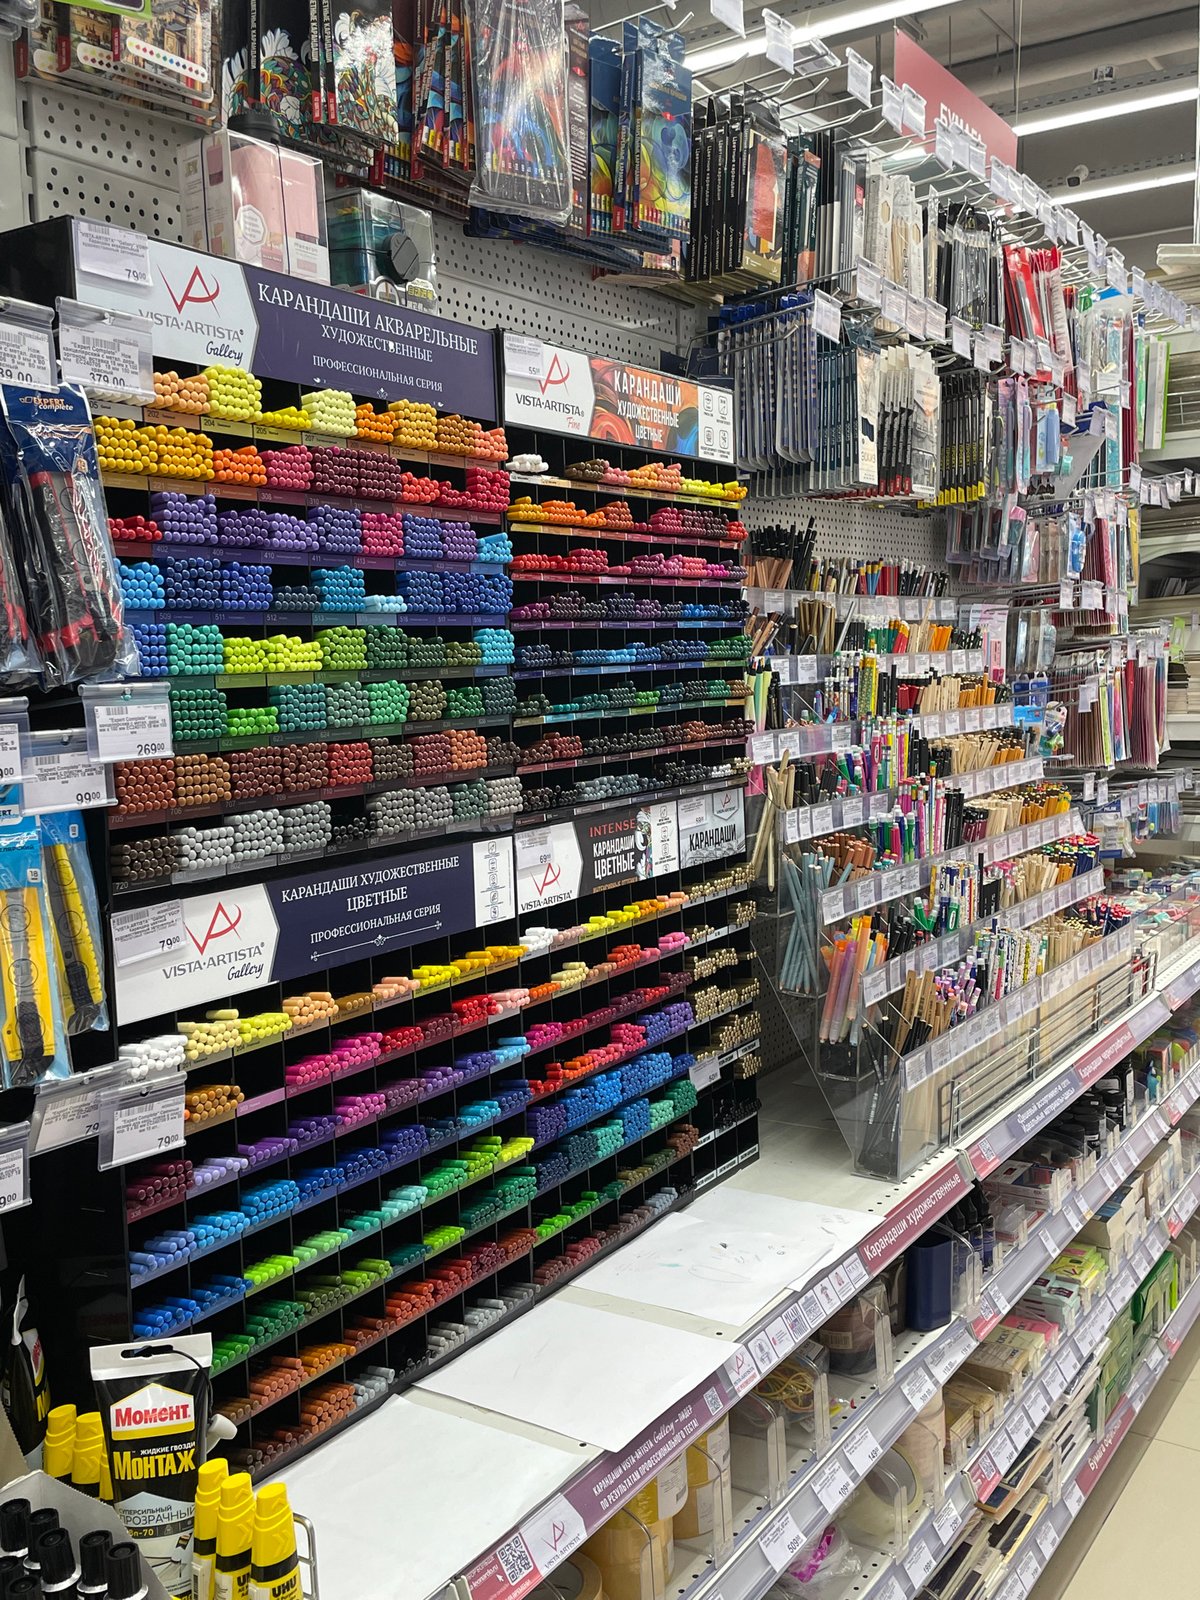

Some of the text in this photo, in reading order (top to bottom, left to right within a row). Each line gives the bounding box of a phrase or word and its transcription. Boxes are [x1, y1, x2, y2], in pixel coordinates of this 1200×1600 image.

[257, 283, 370, 328] КАРАНДАШИ
[375, 314, 479, 356] АКВАРЕЛЬНЫЕ
[206, 341, 244, 367] Gallery
[321, 324, 433, 363] ХУДОЖЕСТВЕННЫЕ
[312, 355, 443, 393] ПРОФЕССИОНАЛЬНАЯ СЕРИЯ
[613, 370, 682, 407] КАРАНДАШИ
[38, 403, 74, 413] complete
[617, 399, 680, 428] ХУДОЖЕСТВЕННЫЕ
[566, 416, 581, 430] Fine
[635, 424, 664, 443] ЦВЕТНЫЕ
[589, 818, 636, 839] INTENSE
[689, 823, 737, 851] КАРАНДАШИ
[592, 834, 635, 858] КАРАНДАШИ
[281, 855, 460, 903] КАРАНДАШИ ХУДОЖЕСТВЕННЫЕ
[594, 852, 635, 881] ЦВЕТНЫЕ
[347, 886, 408, 912] ЦВЕТНЫЕ
[310, 903, 442, 944] ПРОФЕССИОНАЛЬНАЯ СЕРИЯ
[227, 962, 264, 981] Gallery
[863, 1172, 961, 1261] Карандаши художественные
[140, 1441, 196, 1456] ЖИДКИЕ ГВОЗДИ
[592, 1467, 624, 1497] КАРАНДАШИ
[653, 1420, 675, 1444] Gallery
[1087, 1443, 1106, 1472] Бумага
[113, 1448, 196, 1481] МОНТАЖ
[600, 1418, 699, 1511] ПО РЕЗУЛЬТАТАМ ПРОФЕССИОНАЛЬНОГО ТЕСТА!
[271, 1574, 298, 1598] UHU
